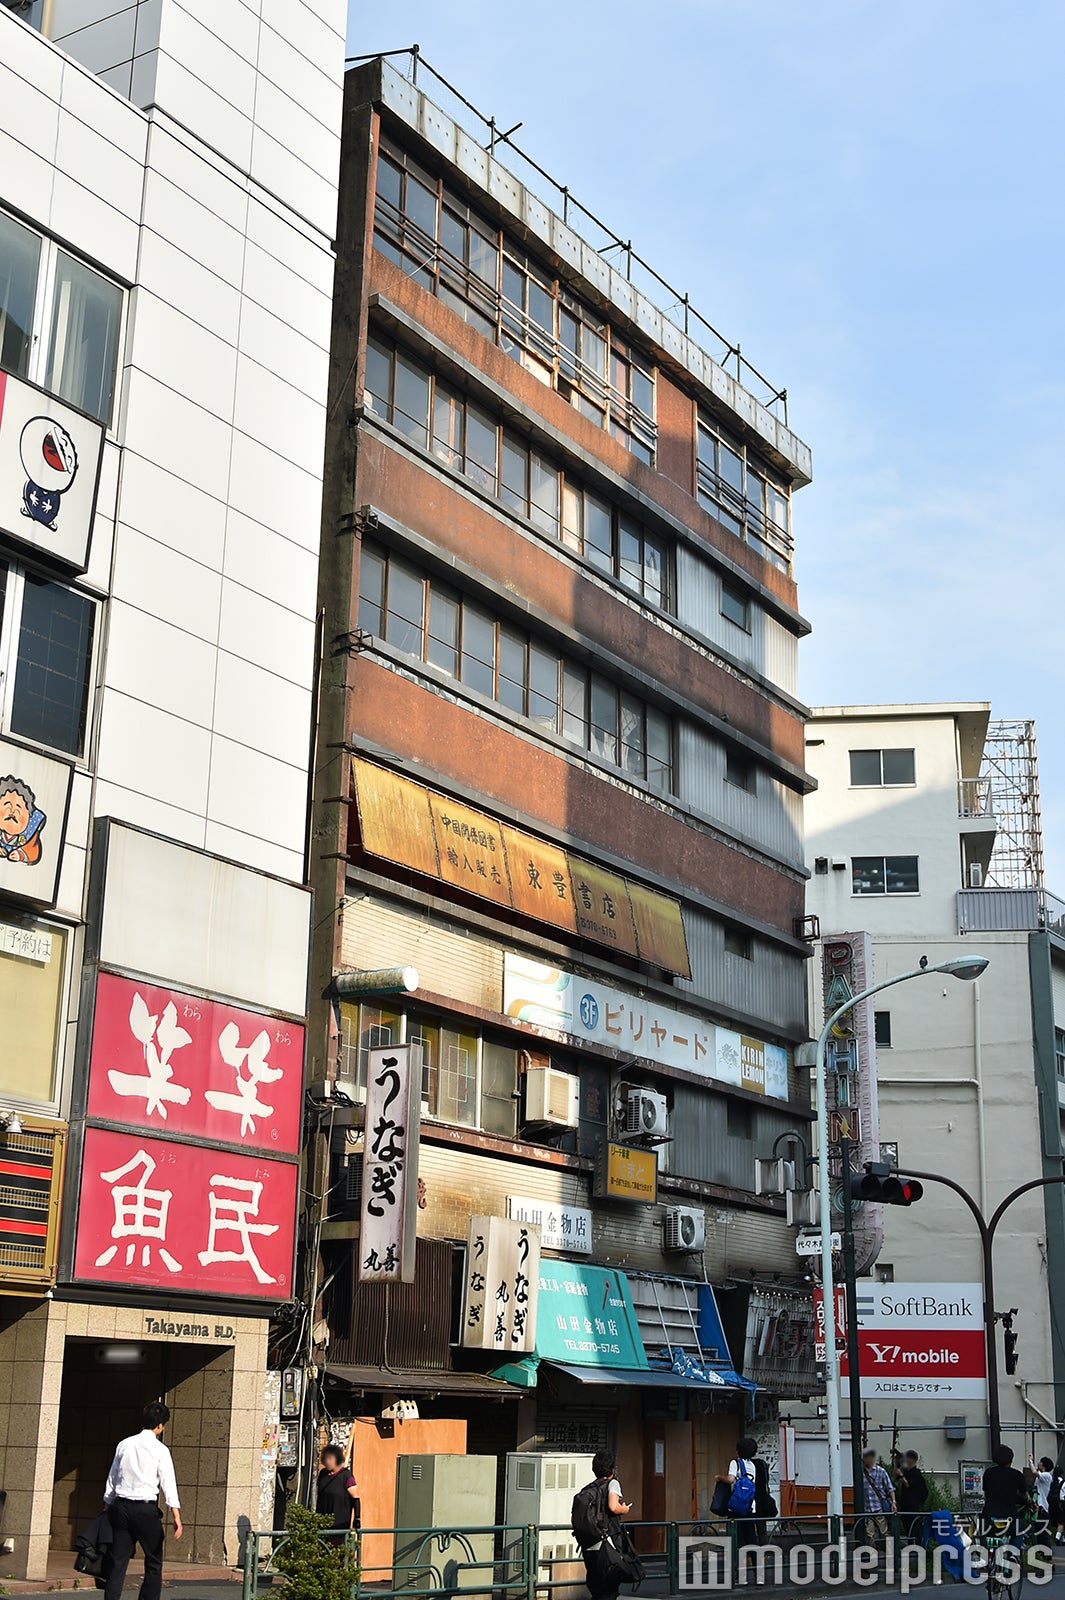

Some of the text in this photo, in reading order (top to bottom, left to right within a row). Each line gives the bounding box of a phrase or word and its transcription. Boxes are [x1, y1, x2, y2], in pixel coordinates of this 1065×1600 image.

[527, 860, 616, 919] 東豊書店
[183, 1003, 201, 1020] わら
[582, 997, 596, 1025] 3F
[275, 1030, 292, 1046] わら
[604, 1002, 708, 1061] ビリヤード
[741, 1044, 764, 1067] KIRIN
[741, 1063, 764, 1085] LEMON
[368, 1056, 405, 1217] うなぎ
[618, 1161, 646, 1183] とまと
[95, 1148, 280, 1285] 魚民
[543, 1235, 554, 1245] TEL
[467, 1235, 486, 1328] うなぎ
[511, 1228, 530, 1344] うなぎ
[880, 1296, 973, 1317] SoftBank
[145, 1317, 236, 1340] Takayama BLD.
[556, 1313, 619, 1337] 山田金物店
[902, 1349, 960, 1364] mobile
[875, 1383, 942, 1393] 入口はこちらです
